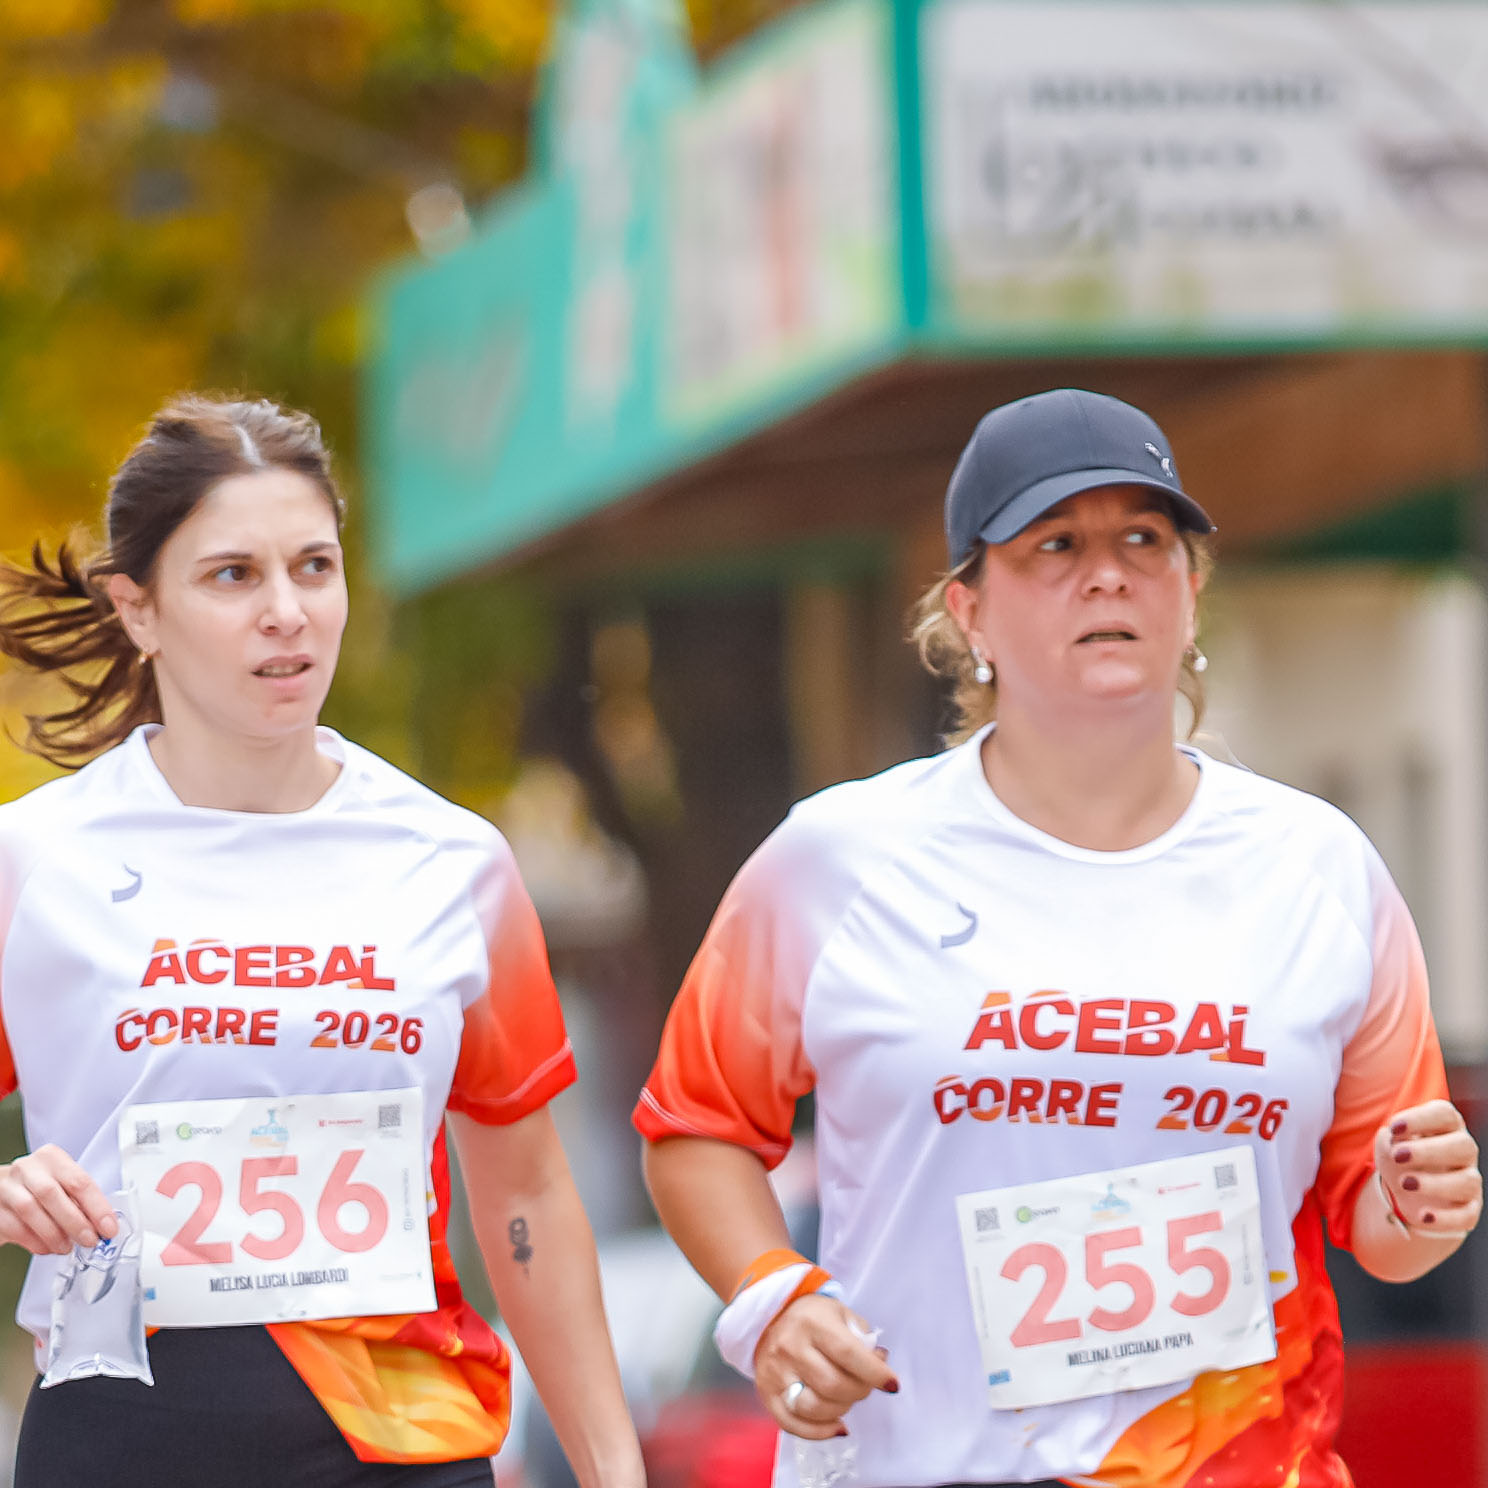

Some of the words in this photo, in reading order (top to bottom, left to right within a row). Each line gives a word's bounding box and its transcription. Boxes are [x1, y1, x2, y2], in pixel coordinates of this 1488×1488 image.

[139, 938, 396, 992] ACEBAL
[114, 1005, 279, 1053] CORRE
[310, 1010, 425, 1056] 2026
[963, 989, 1267, 1067] ACEBAL
[932, 1074, 1124, 1128] CORRE
[1156, 1085, 1290, 1142] 2026
[154, 1147, 390, 1268] 256
[999, 1209, 1233, 1350] 255
[1068, 1348, 1111, 1366] MELINA
[1114, 1339, 1162, 1358] LUCIANA
[1164, 1332, 1193, 1349] PAPA
